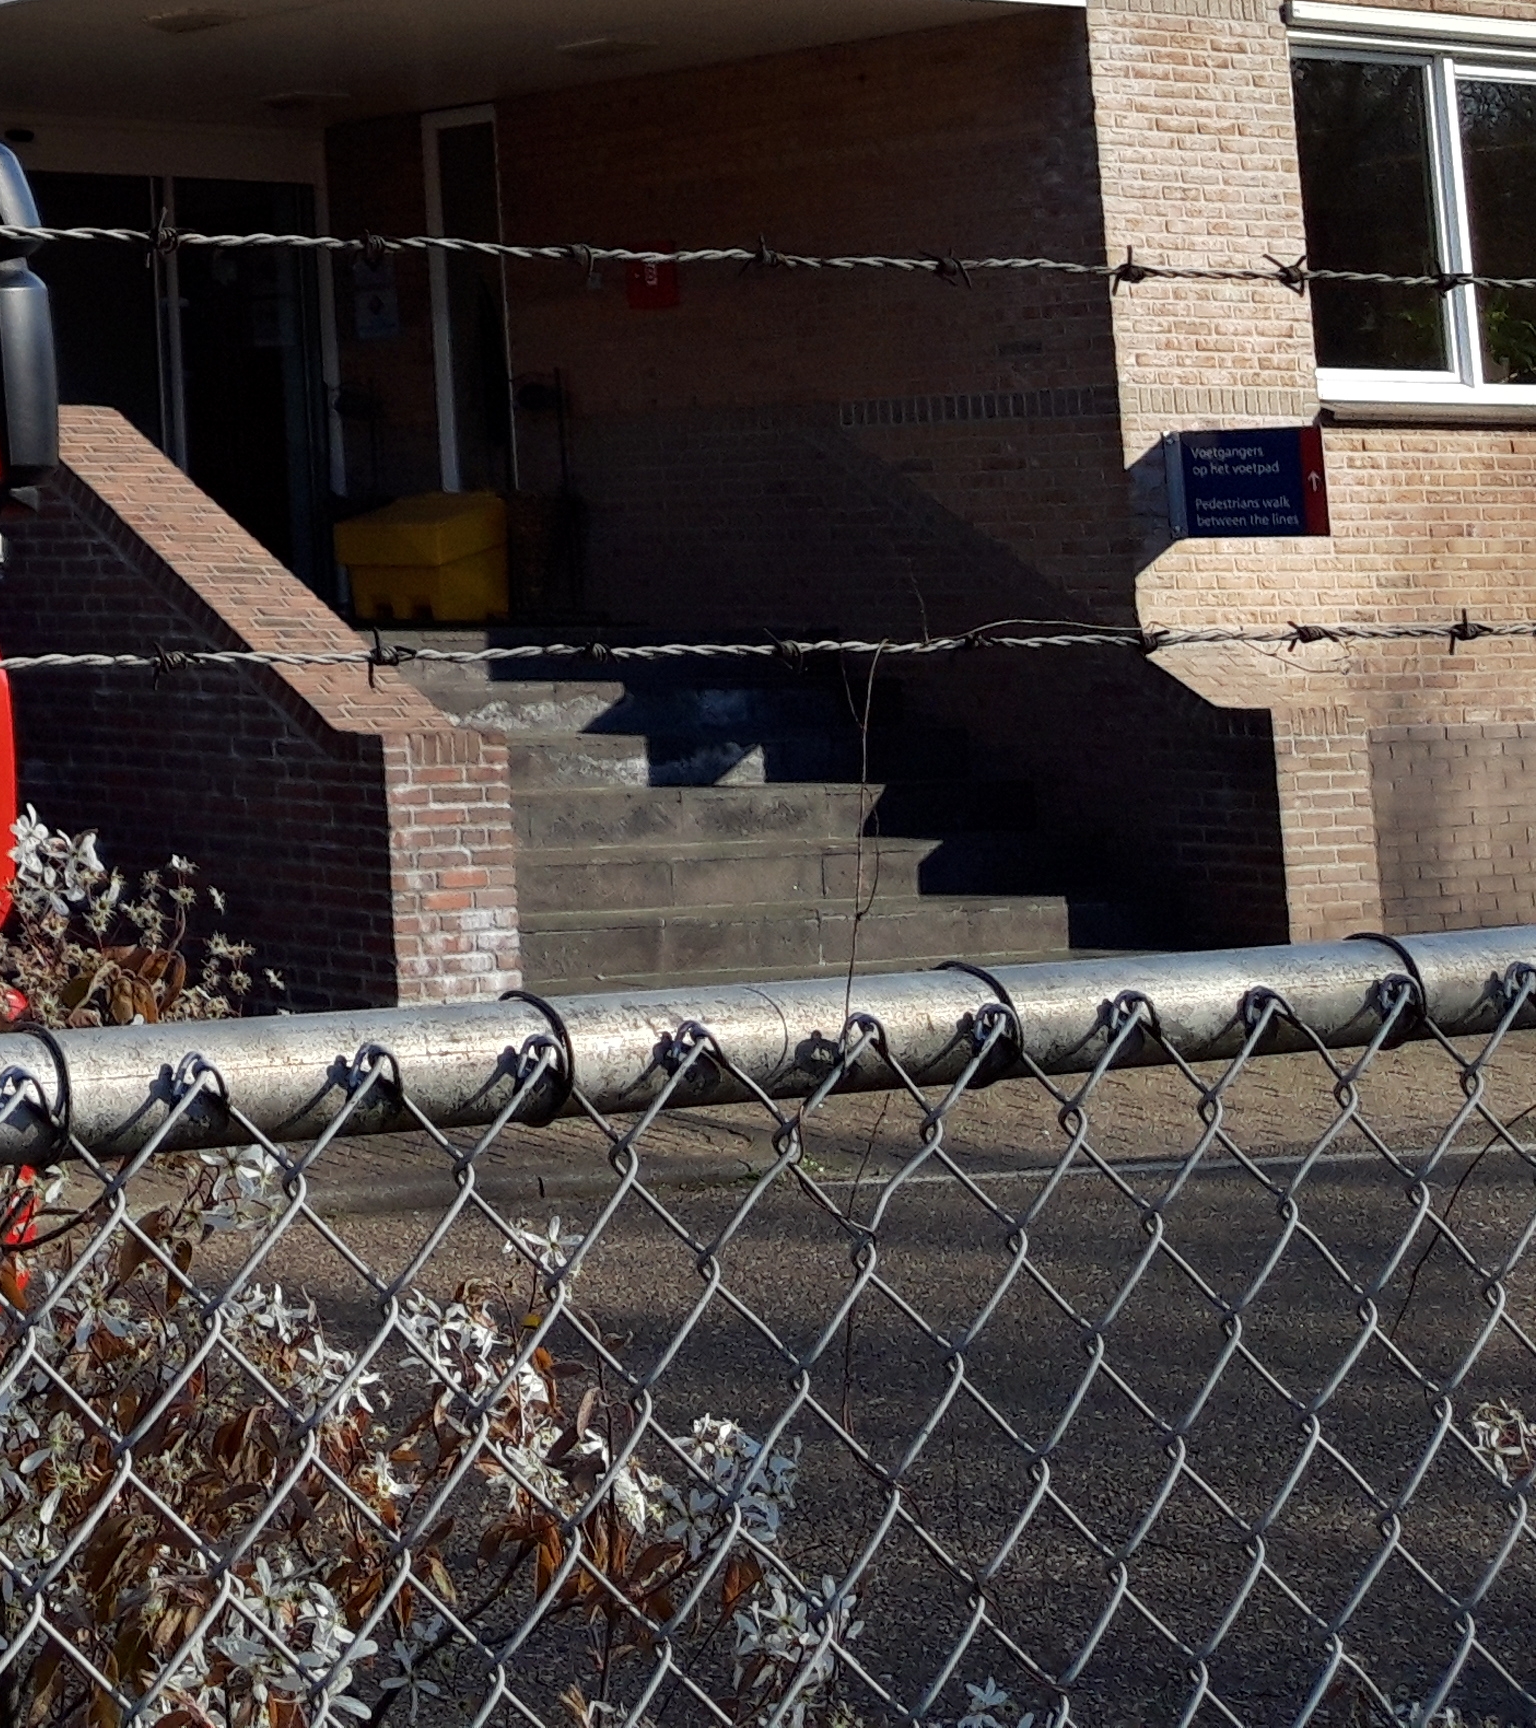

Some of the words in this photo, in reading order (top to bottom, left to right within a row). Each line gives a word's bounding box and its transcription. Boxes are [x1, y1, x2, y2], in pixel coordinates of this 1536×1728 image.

[1191, 446, 1265, 461] Voetgangers
[1192, 466, 1208, 477] op
[1210, 462, 1229, 475] het
[1232, 461, 1280, 477] voetpad
[1195, 497, 1261, 511] Pedestrians
[1263, 495, 1291, 509] walk
[1197, 513, 1247, 527] between
[1250, 513, 1270, 526] the
[1272, 512, 1299, 526] lines
